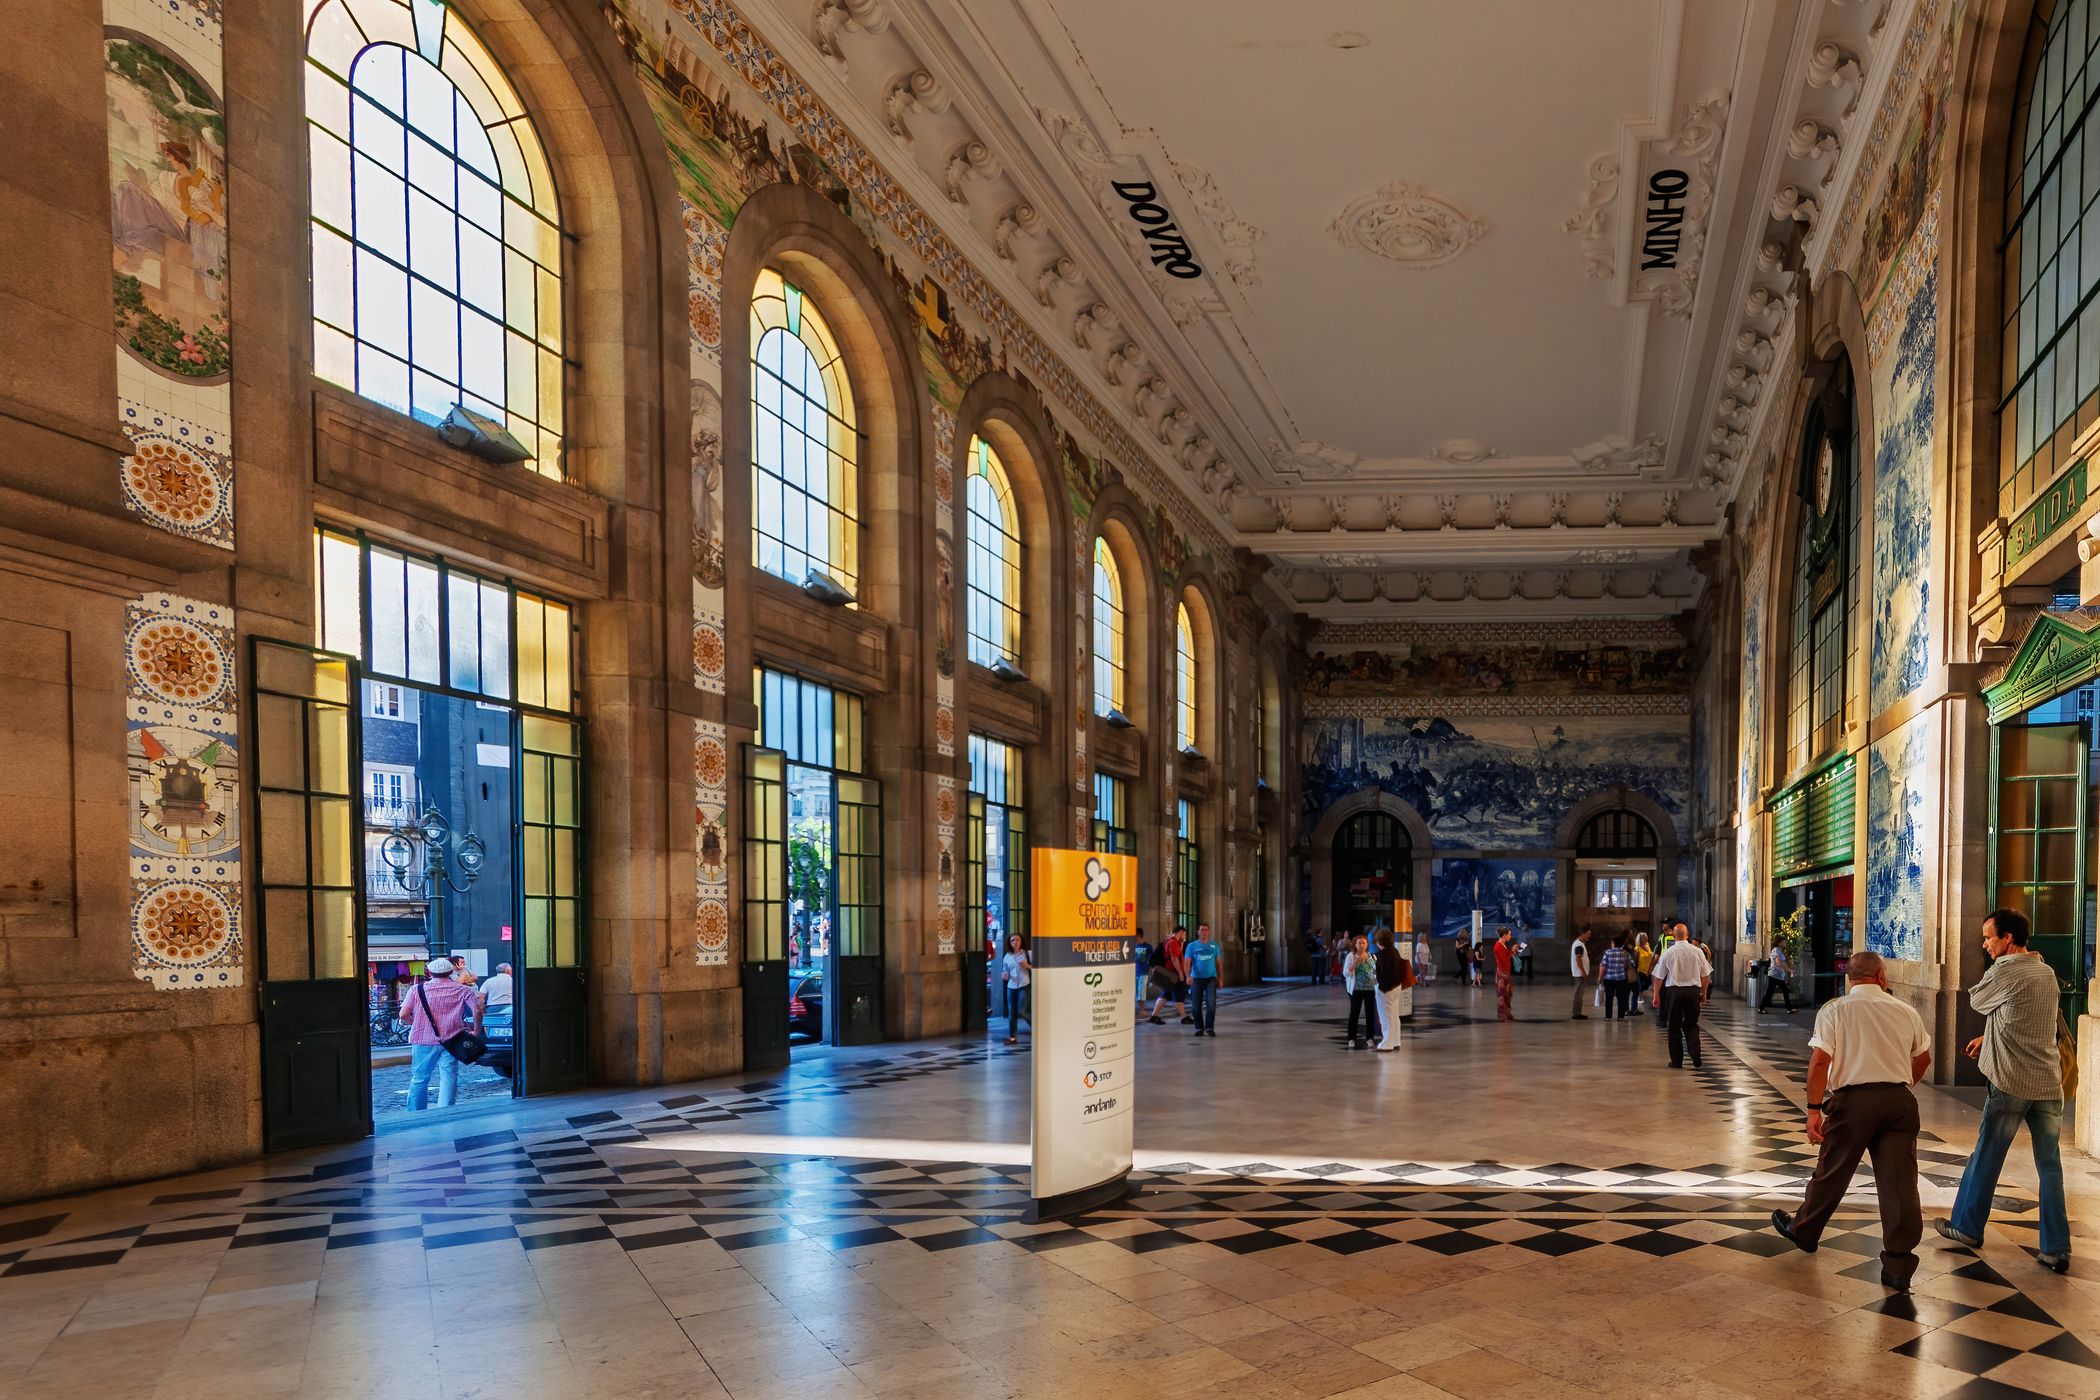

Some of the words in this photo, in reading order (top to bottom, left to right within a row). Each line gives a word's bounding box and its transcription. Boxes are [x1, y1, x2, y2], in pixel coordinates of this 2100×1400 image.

[1641, 169, 1689, 272] MINHO
[1111, 180, 1202, 279] DOVRO
[2016, 477, 2077, 556] SAIDA
[1079, 903, 1111, 918] CENTRO
[1112, 904, 1120, 917] DA
[1085, 916, 1128, 930] MOBILIDADE
[1072, 941, 1096, 953] PONTO
[1085, 952, 1105, 962] TICKET
[1100, 1071, 1113, 1081] STCP
